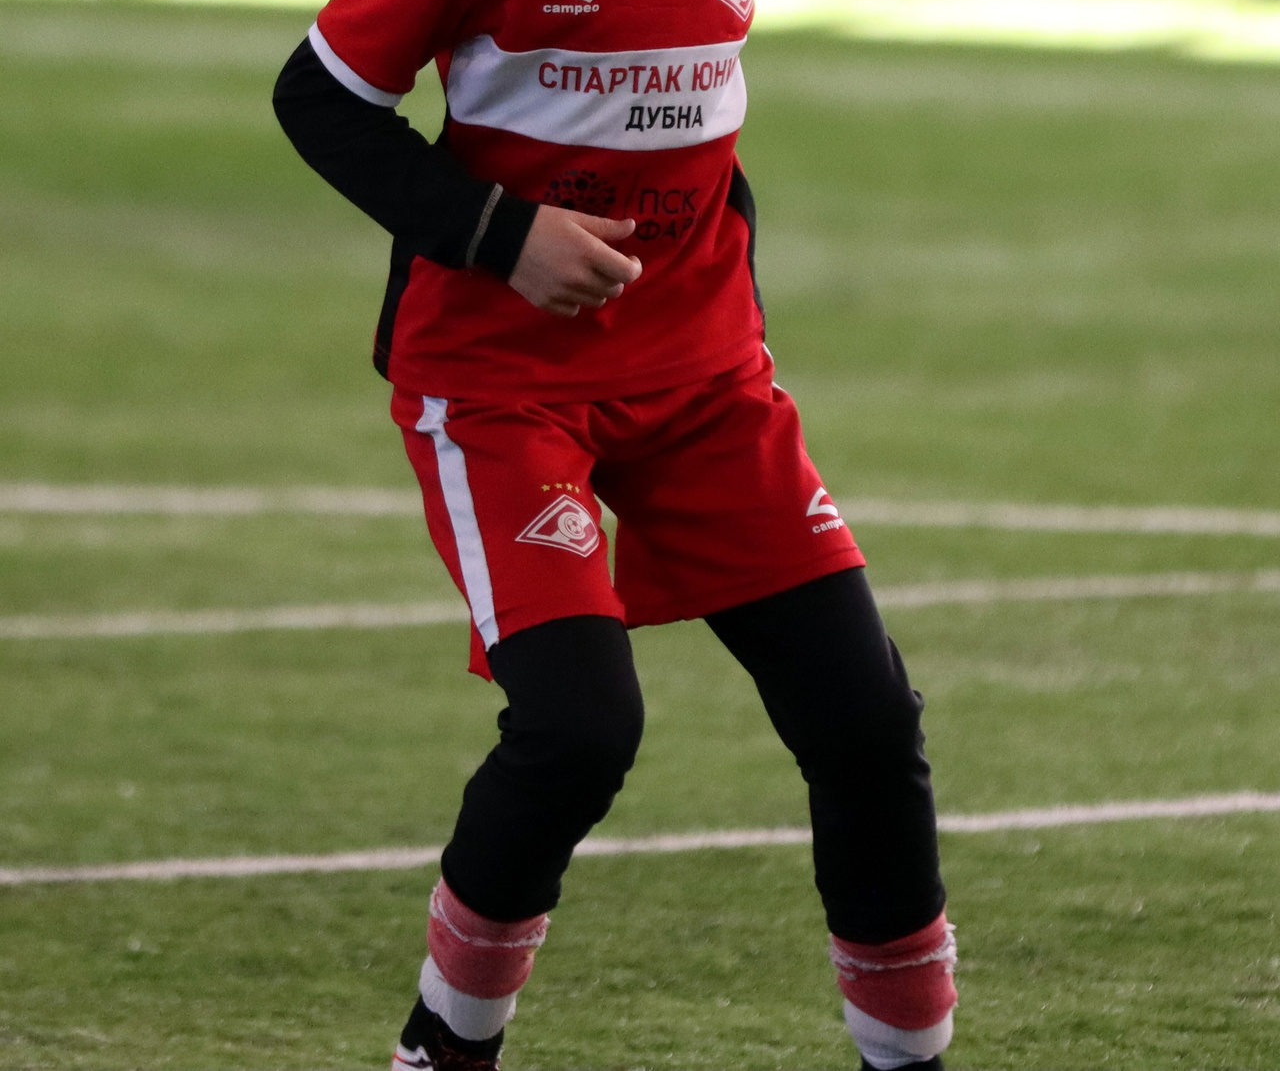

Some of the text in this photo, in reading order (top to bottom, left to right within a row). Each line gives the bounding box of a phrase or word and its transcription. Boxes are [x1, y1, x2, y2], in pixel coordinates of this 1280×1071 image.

[543, 3, 600, 15] campeo
[539, 61, 684, 94] СПАРТАК
[625, 104, 703, 131] ДУБНА
[638, 188, 698, 214] ПСК
